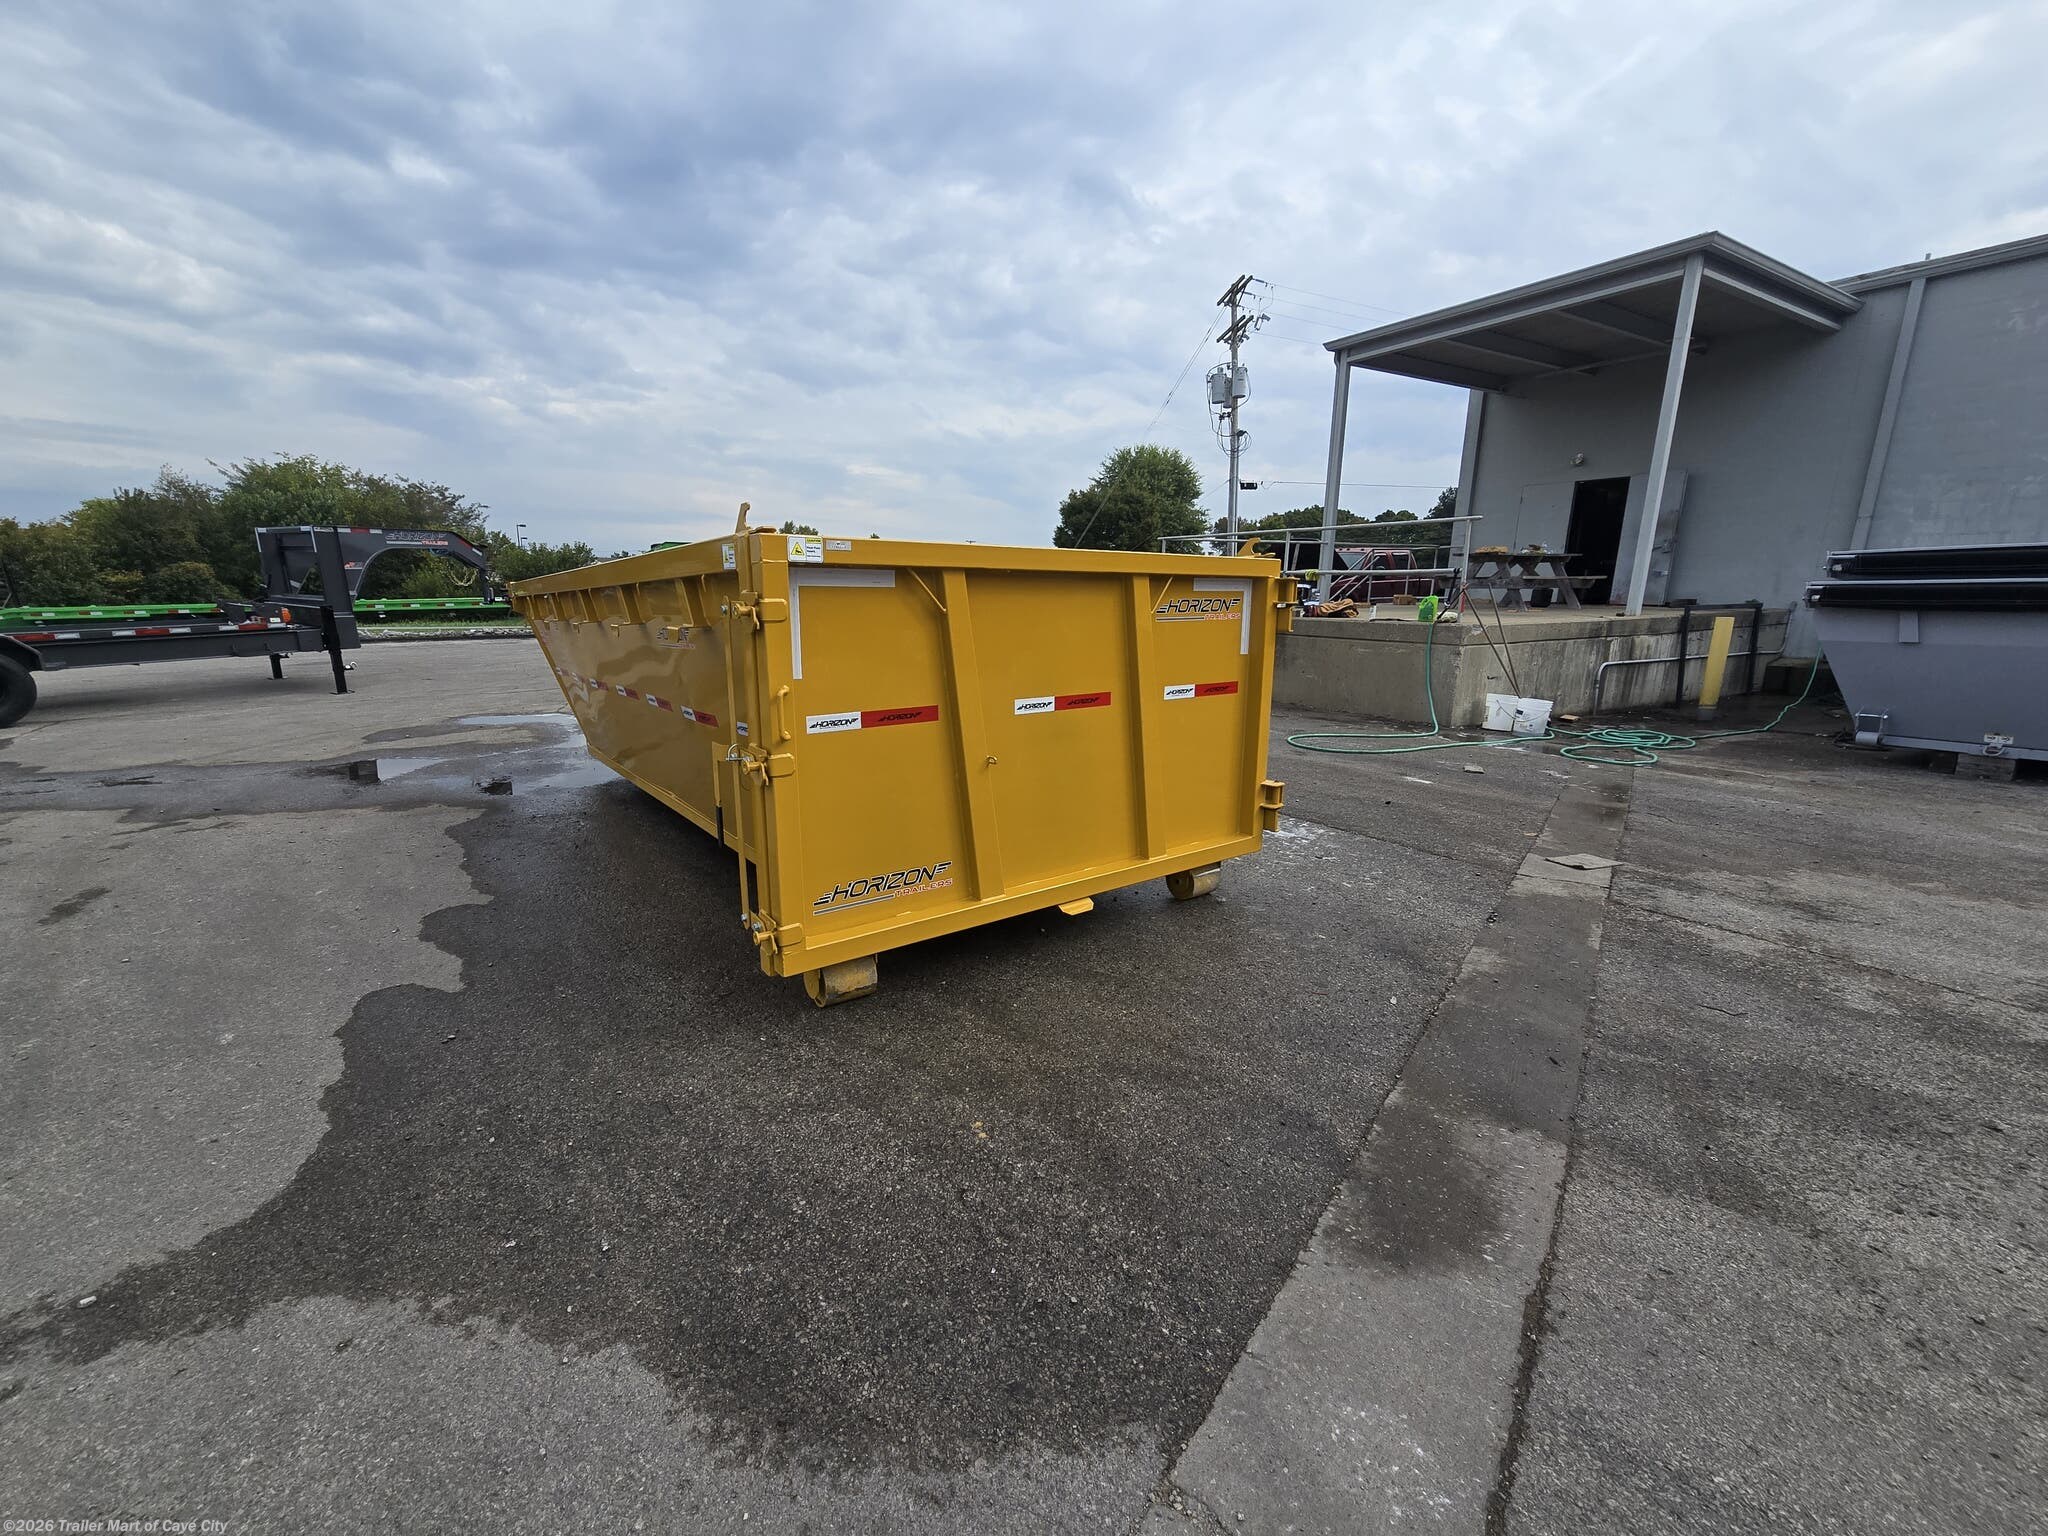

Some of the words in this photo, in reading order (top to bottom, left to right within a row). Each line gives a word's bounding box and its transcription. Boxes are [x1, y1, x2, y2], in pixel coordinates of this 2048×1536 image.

[391, 531, 443, 541] HORIZON
[1164, 598, 1234, 613] HORIZON
[1019, 702, 1051, 710] HORIZON
[813, 718, 857, 728] HORIZON
[828, 864, 941, 903] HORIZON
[894, 878, 953, 897] TRAILERS
